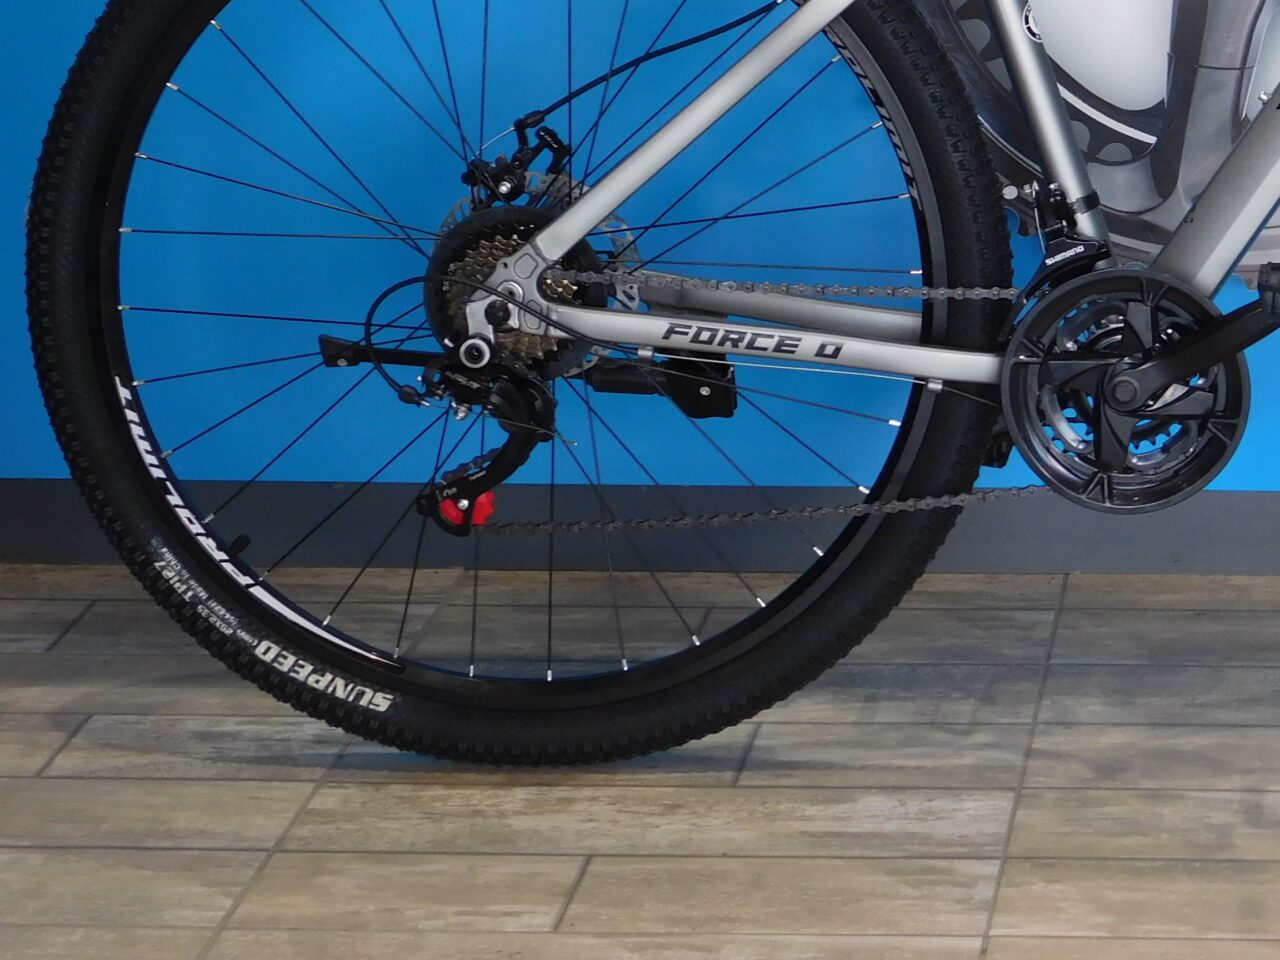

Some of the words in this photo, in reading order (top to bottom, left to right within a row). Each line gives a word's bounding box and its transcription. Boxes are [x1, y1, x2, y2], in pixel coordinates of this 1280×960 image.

[1045, 245, 1085, 266] SHIMANO
[661, 321, 803, 355] FORCE
[115, 376, 256, 588] PROLIMIT
[255, 640, 395, 713] SUNPEED
